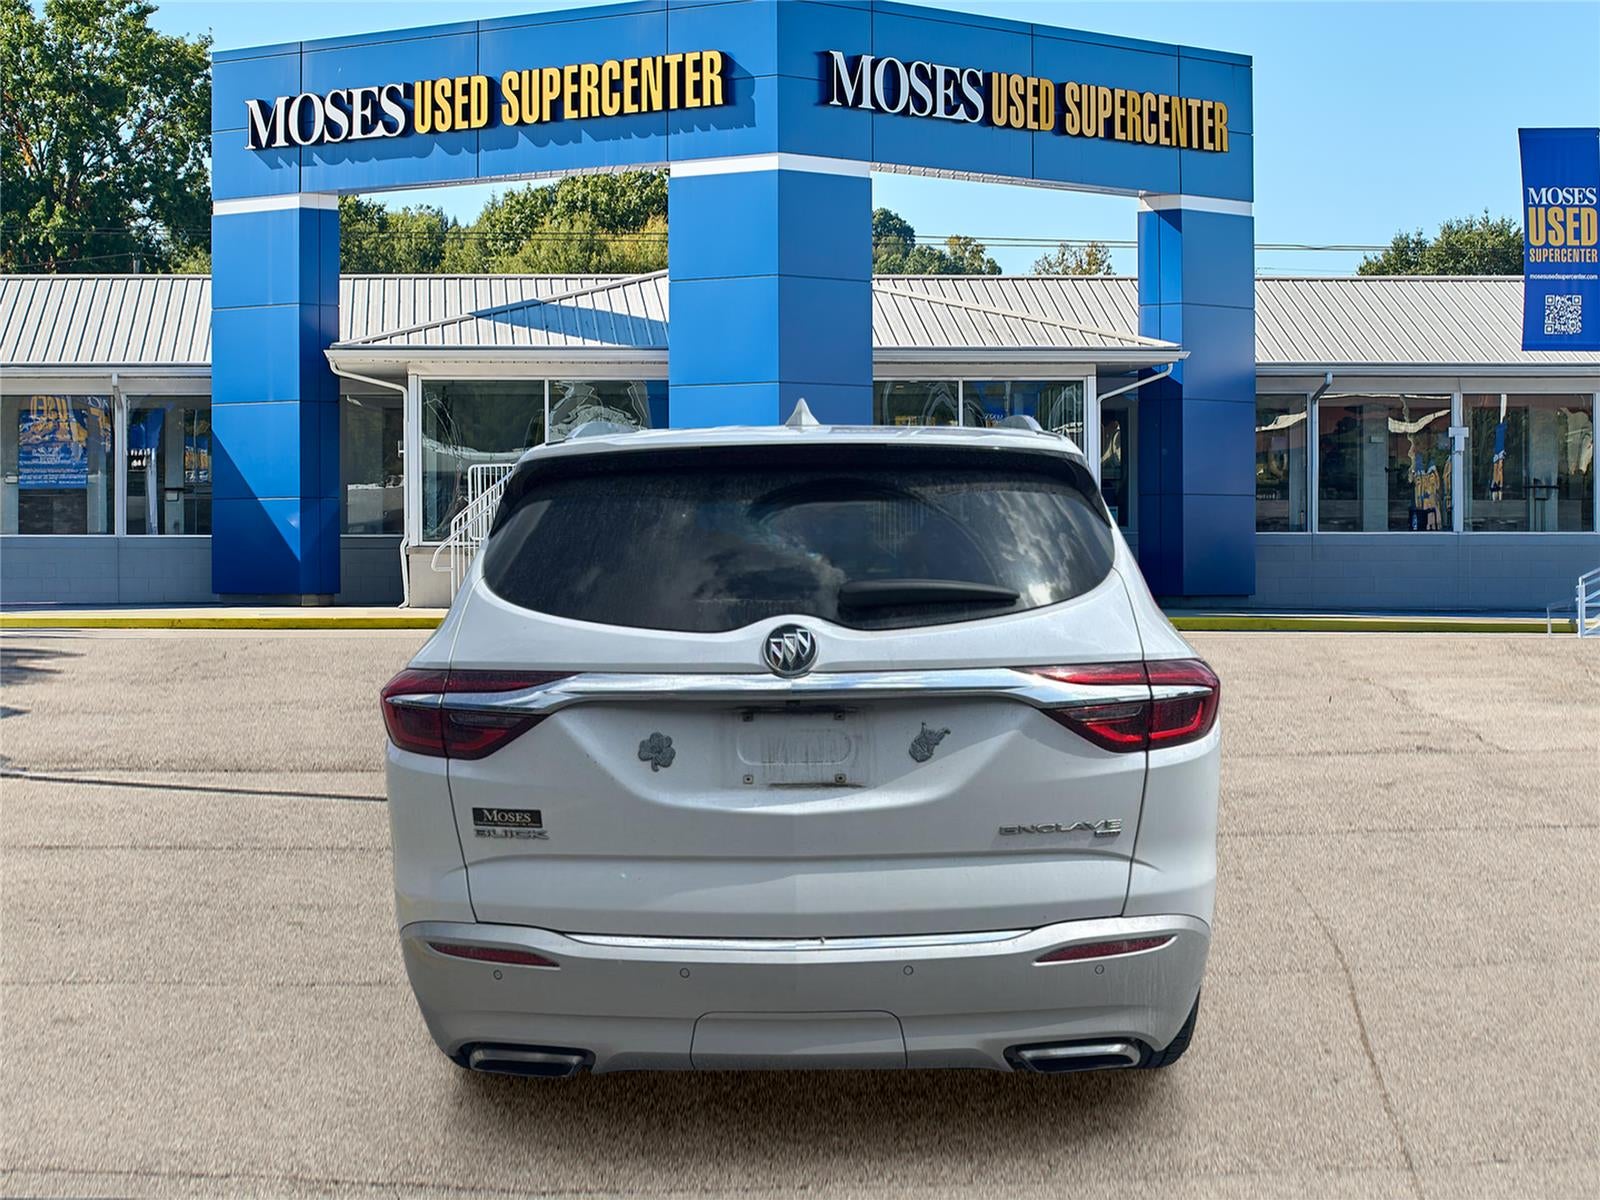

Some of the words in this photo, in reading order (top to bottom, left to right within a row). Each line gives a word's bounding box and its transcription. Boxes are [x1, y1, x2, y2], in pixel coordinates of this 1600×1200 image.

[244, 82, 410, 151] MOSES
[413, 74, 490, 135] USED
[500, 49, 725, 128] SUPERCENTER
[828, 49, 984, 124] MOSES
[991, 71, 1055, 132] USED
[1064, 81, 1230, 153] SUPERCENTER
[1527, 186, 1598, 206] MOSES
[1528, 206, 1598, 247] USED
[1529, 248, 1598, 263] SUPERCENTER
[998, 819, 1122, 836] ENCLAVE
